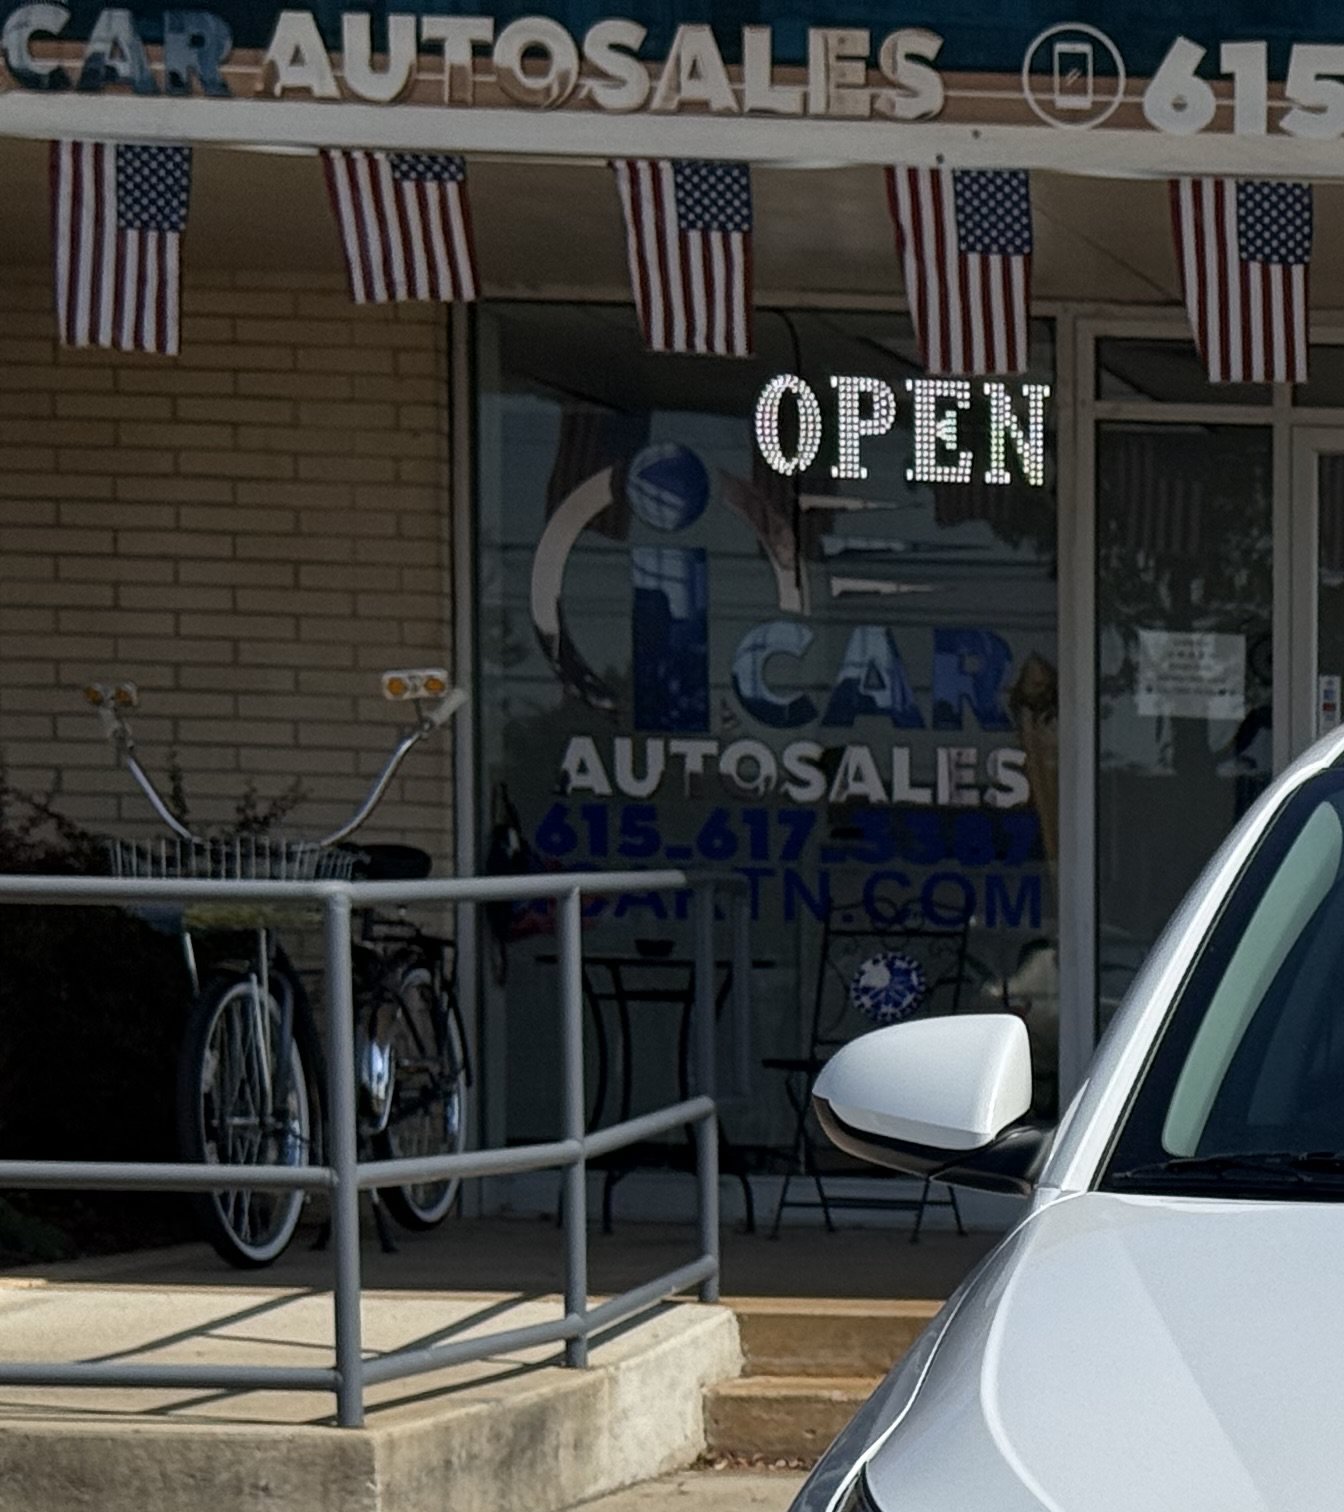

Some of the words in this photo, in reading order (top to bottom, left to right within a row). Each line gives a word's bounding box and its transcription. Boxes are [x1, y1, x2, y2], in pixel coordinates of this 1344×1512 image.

[2, 3, 232, 97] CAR
[260, 10, 946, 121] AUTOSALES
[754, 373, 1051, 486] OPEN
[731, 619, 1014, 731] CAR
[561, 735, 1032, 809] AUTOSALES
